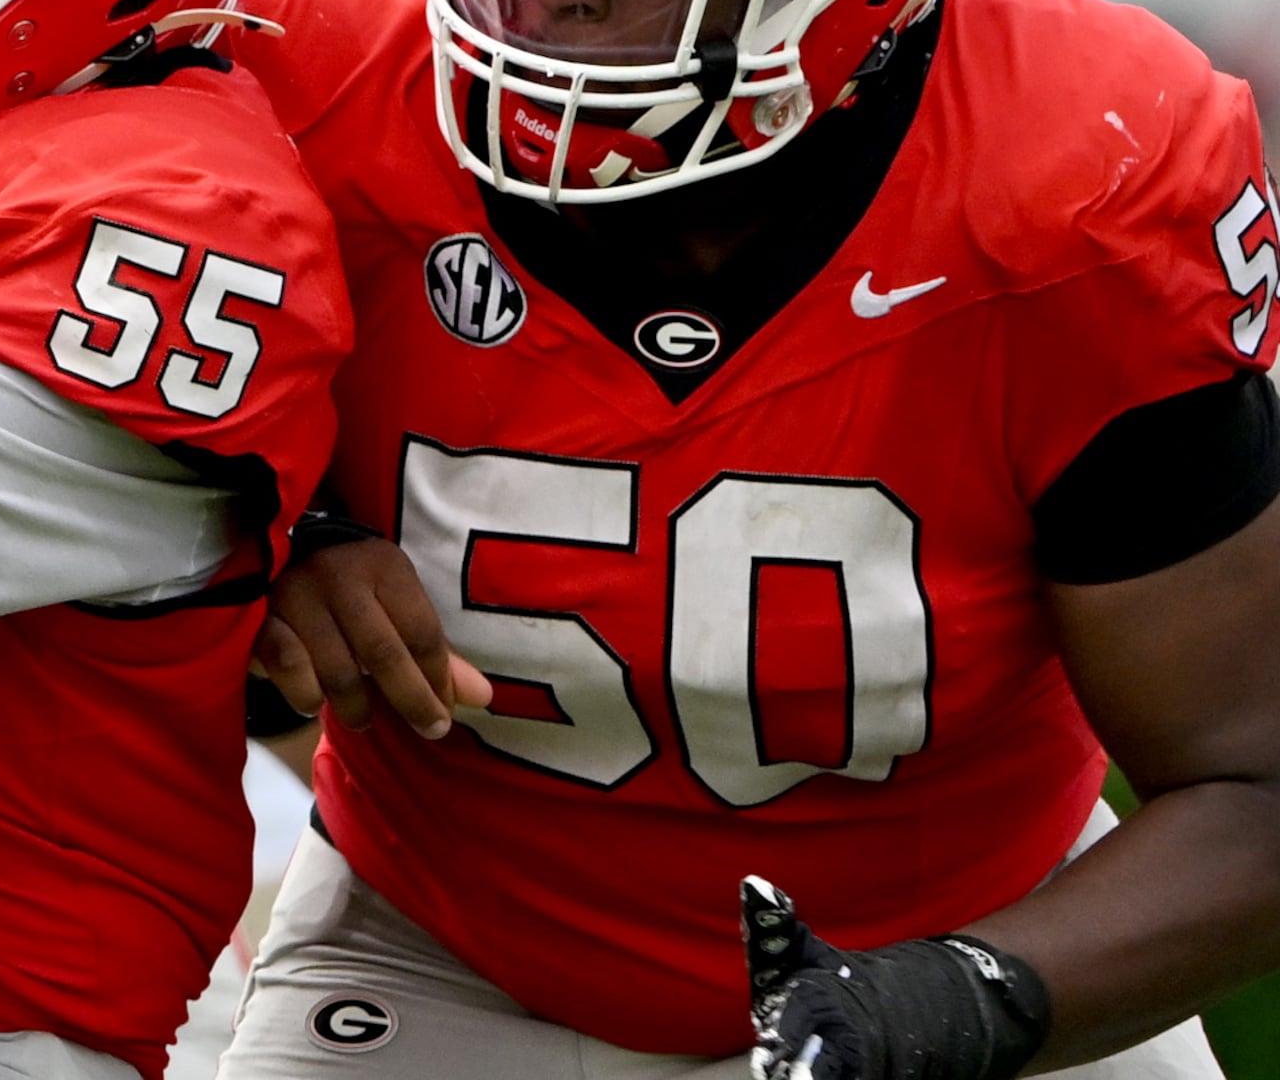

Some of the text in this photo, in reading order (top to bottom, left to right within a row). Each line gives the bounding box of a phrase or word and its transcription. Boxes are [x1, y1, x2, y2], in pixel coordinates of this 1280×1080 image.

[46, 216, 286, 420] 55
[432, 241, 517, 341] SEC
[397, 432, 933, 809] 50
